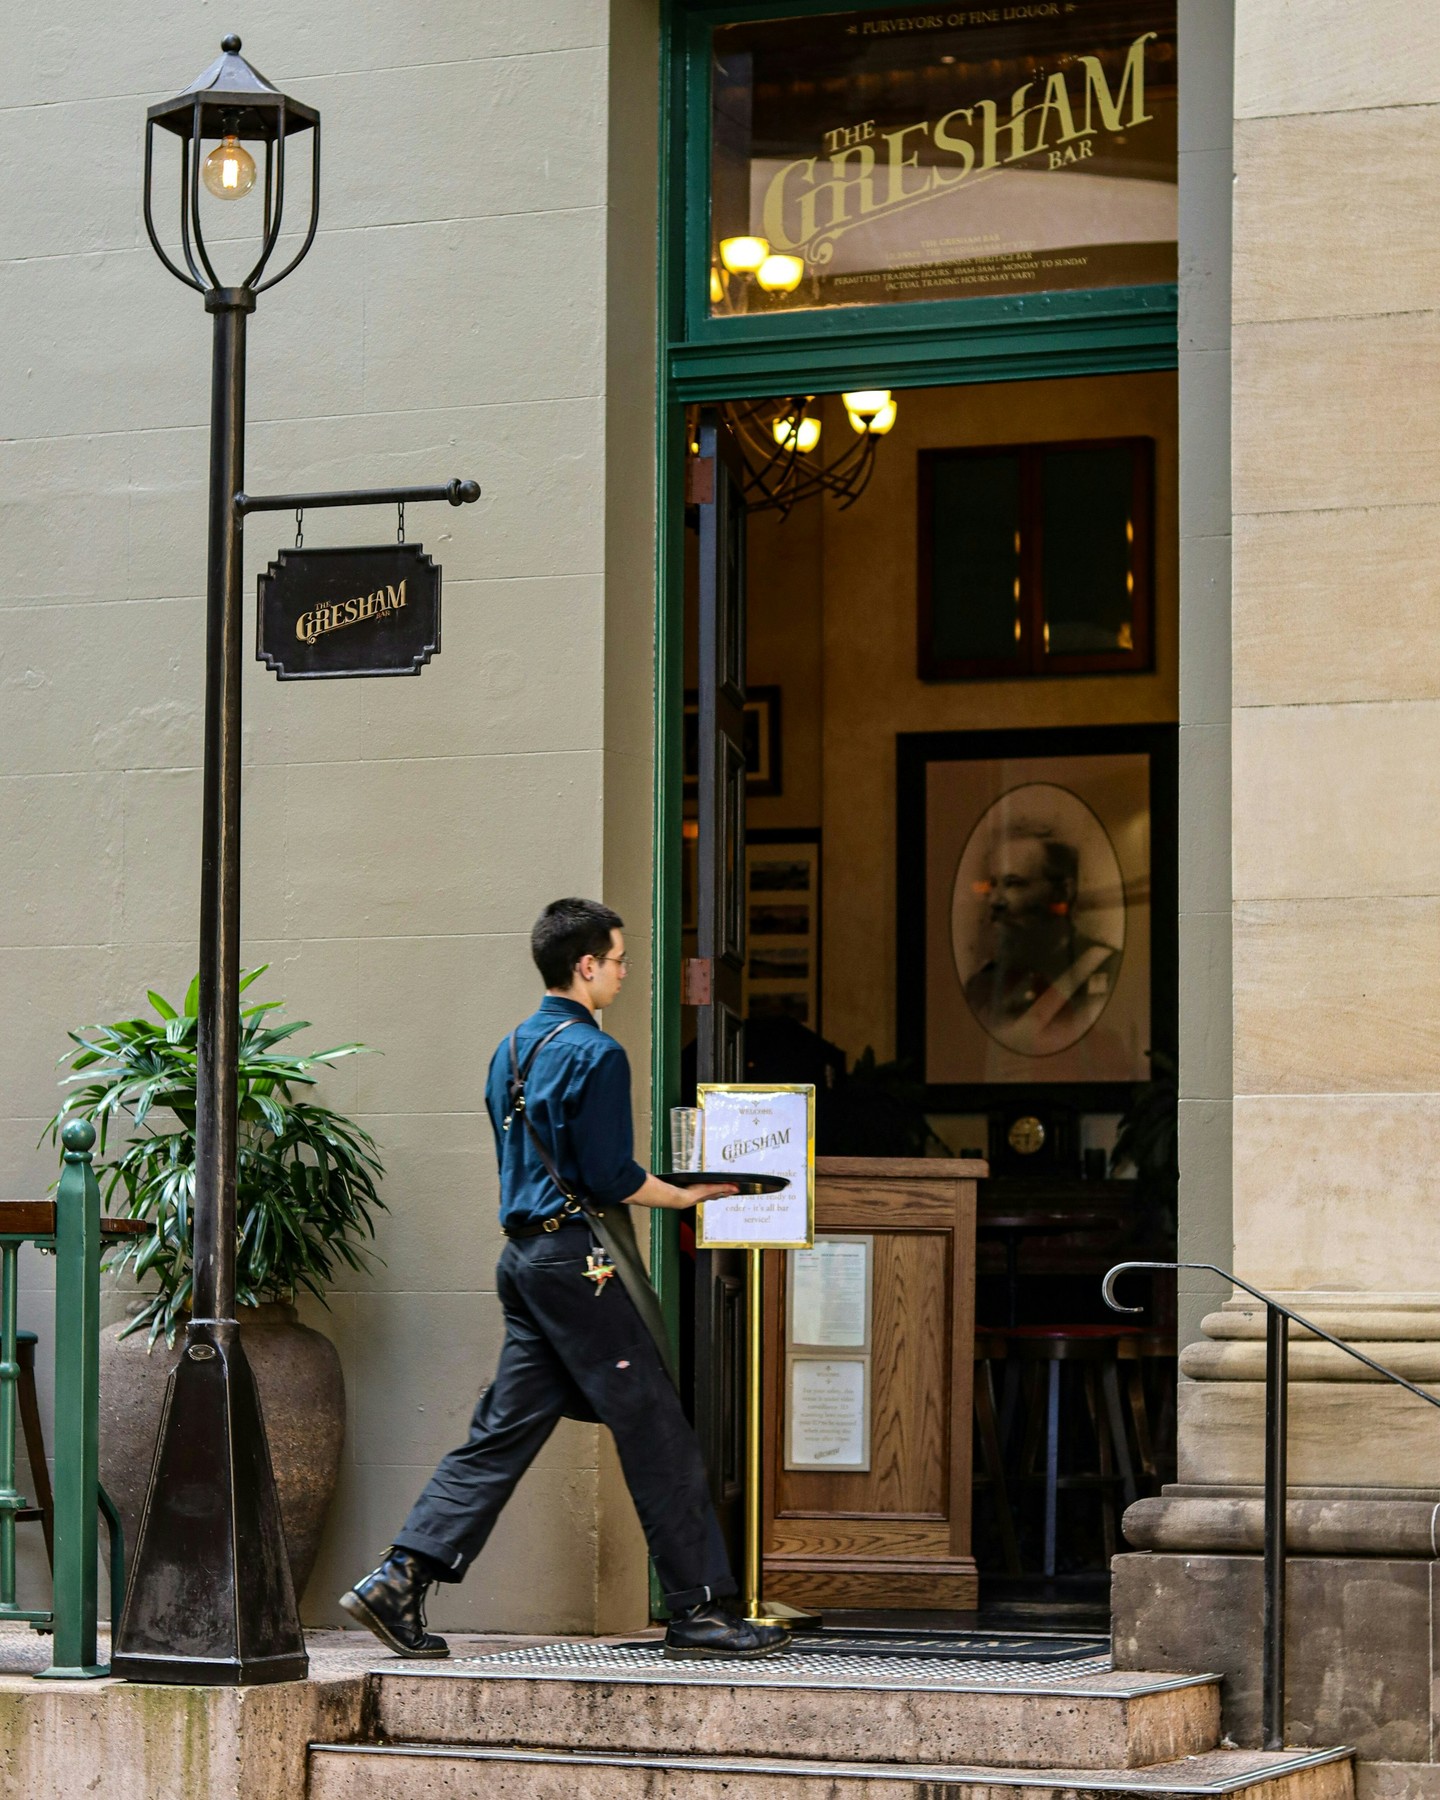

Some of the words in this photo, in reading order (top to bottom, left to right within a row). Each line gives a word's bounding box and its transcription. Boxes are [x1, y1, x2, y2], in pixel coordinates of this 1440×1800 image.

[862, 15, 944, 35] PURVEYORS
[947, 13, 967, 27] OF
[969, 9, 1000, 24] FINE
[1003, 3, 1060, 20] LIQUOR
[763, 31, 1158, 256] GRESHAM
[824, 119, 877, 153] THE
[1048, 140, 1093, 171] BAR
[833, 274, 881, 286] PERMITTED
[883, 271, 920, 281] TRADING
[1002, 261, 1039, 271] MONDAY
[1041, 259, 1054, 268] TO
[1055, 257, 1088, 267] SUNDAY
[922, 276, 960, 287] TRADING
[961, 274, 989, 284] HOURS
[991, 272, 1009, 281] MAY
[295, 578, 408, 642] GRESHAM
[314, 600, 331, 611] THE
[722, 1127, 791, 1162] GRESHAM
[777, 1169, 797, 1177] make
[725, 1204, 746, 1212] order
[753, 1204, 765, 1212] it's
[766, 1204, 775, 1212] all
[777, 1204, 789, 1212] bar
[744, 1215, 771, 1223] service!
